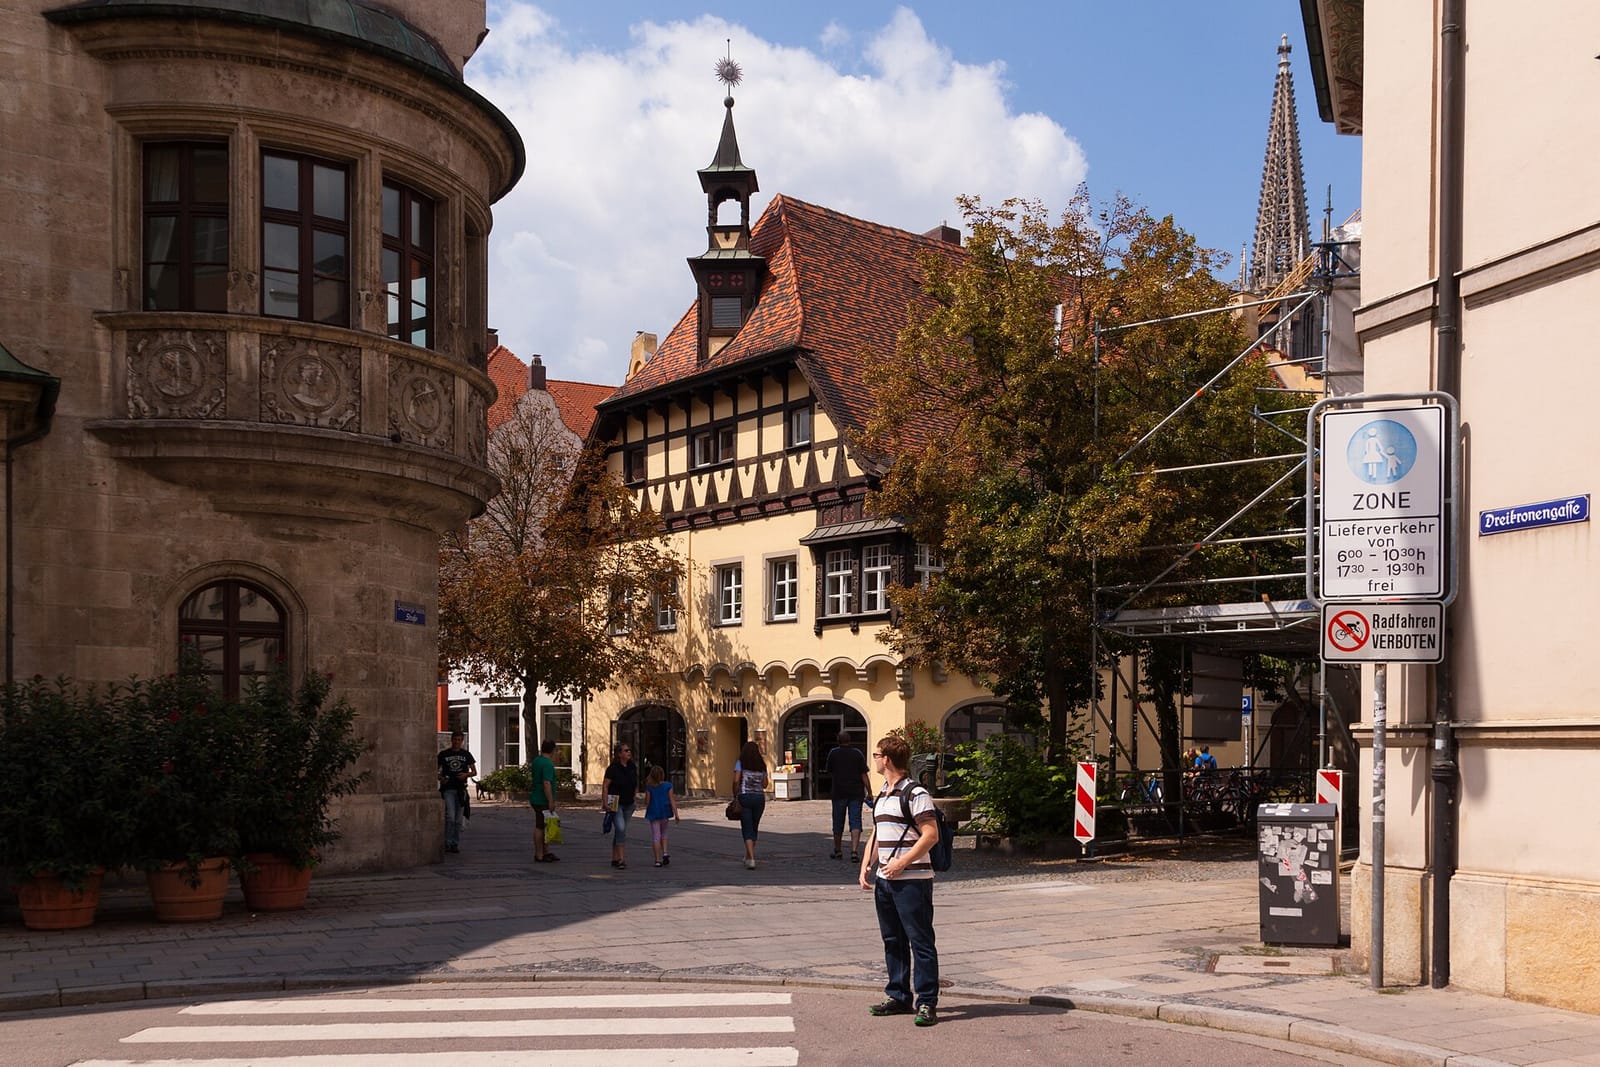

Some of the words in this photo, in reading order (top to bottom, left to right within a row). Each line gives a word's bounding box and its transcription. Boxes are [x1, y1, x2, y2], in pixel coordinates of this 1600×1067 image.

[1352, 491, 1411, 510] ZONE
[1328, 521, 1436, 537] Lieferverkehr
[1368, 538, 1395, 548] von
[1367, 580, 1395, 592] frei
[1372, 613, 1436, 629] Radfahren
[1371, 633, 1436, 649] VERBOTEN
